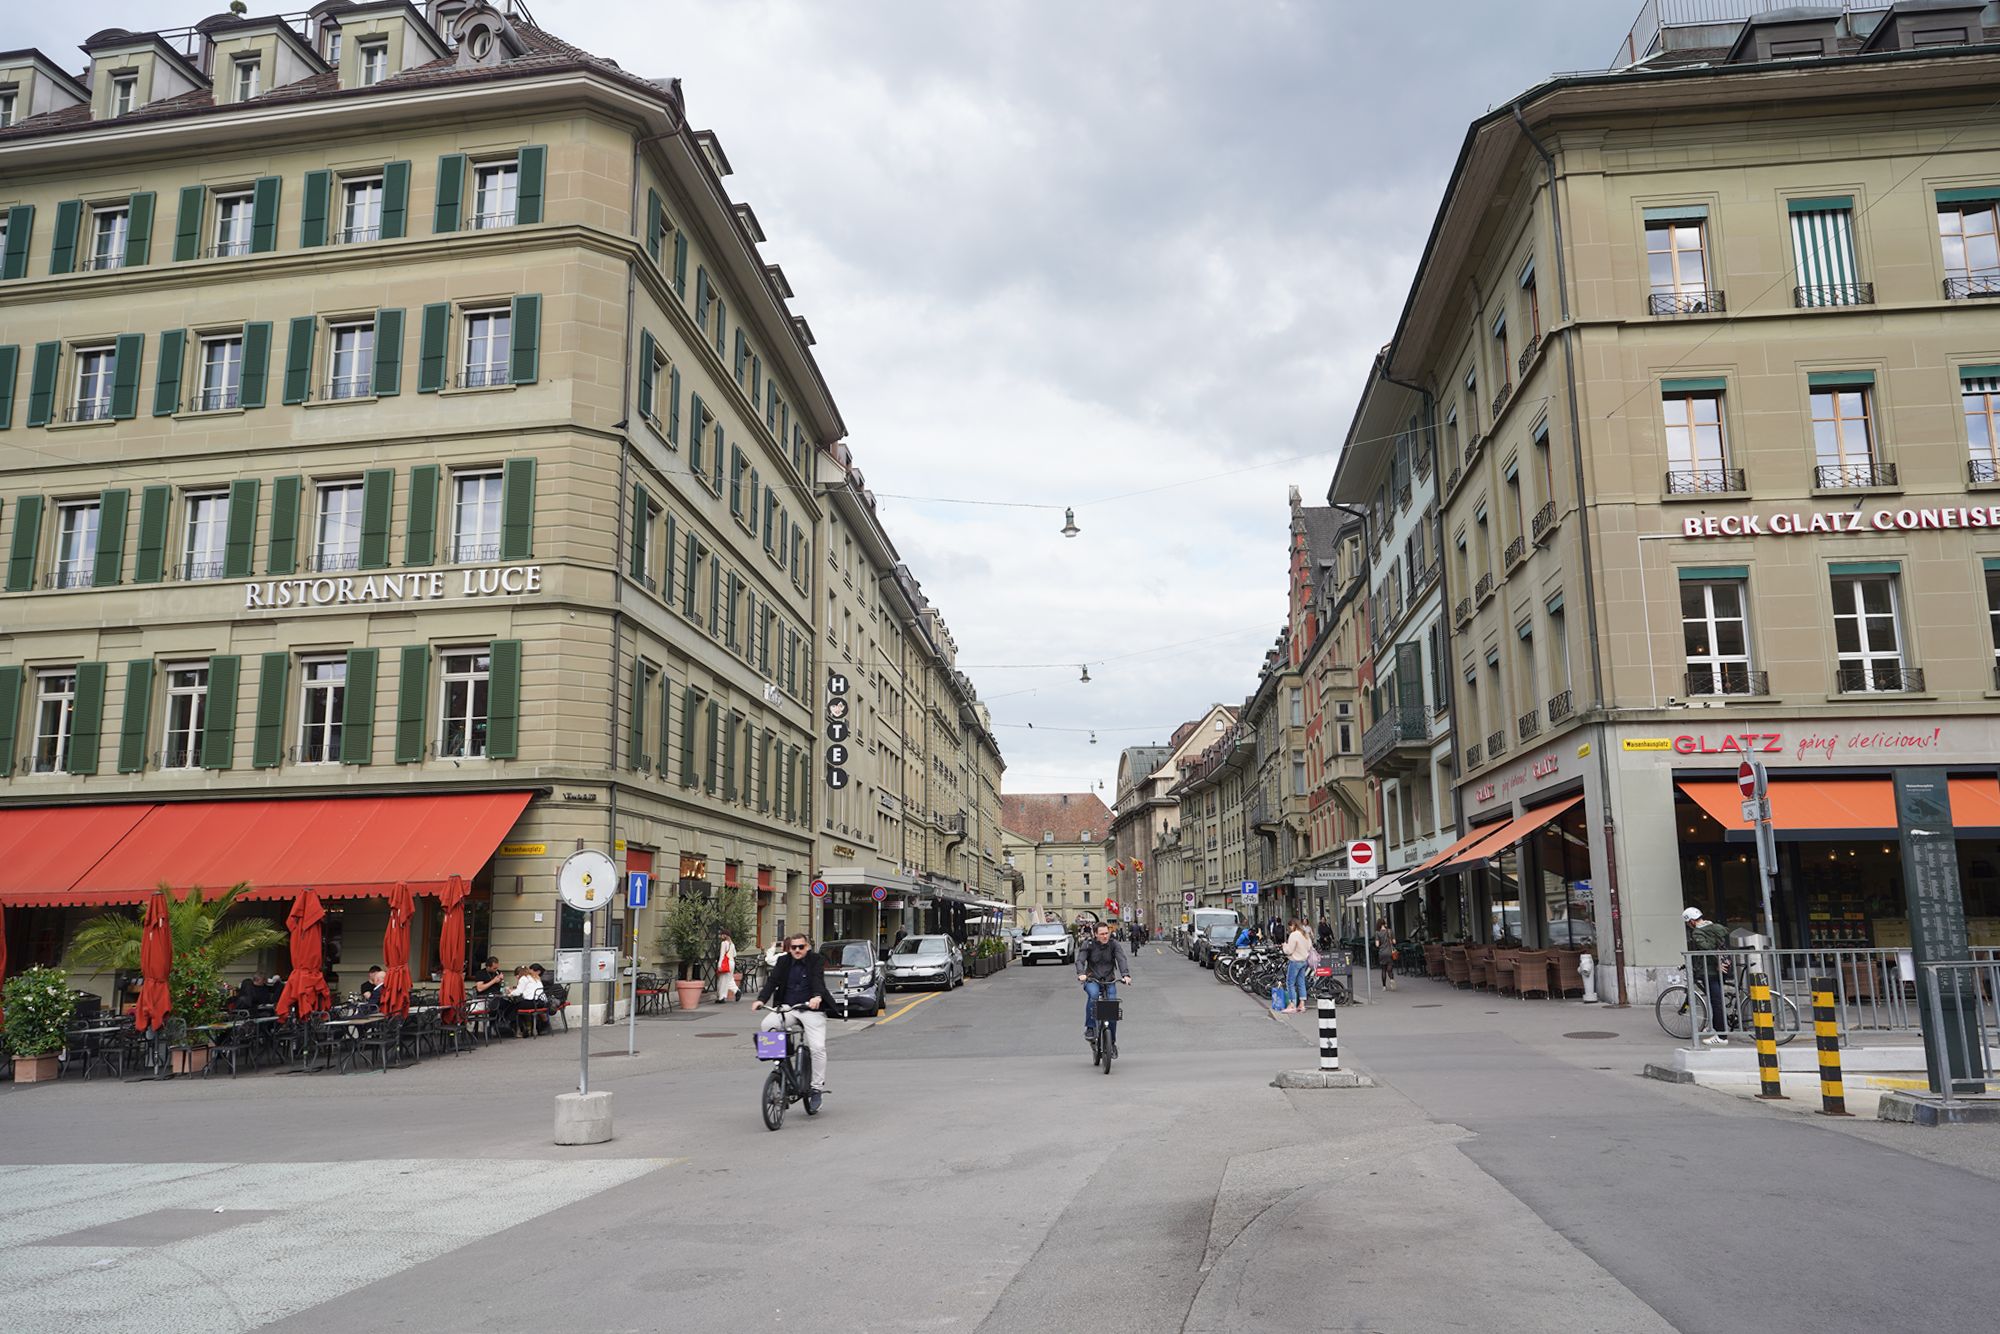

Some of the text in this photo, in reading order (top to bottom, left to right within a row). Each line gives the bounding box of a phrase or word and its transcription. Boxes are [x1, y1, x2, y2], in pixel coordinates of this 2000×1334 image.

[1683, 506, 2000, 538] BECK GLATZ CONFISE
[245, 566, 541, 608] RISTORANTE LUCE
[1626, 740, 1669, 749] Waisenhausplatz
[1675, 734, 1782, 754] GLATZ
[1245, 882, 1254, 893] P
